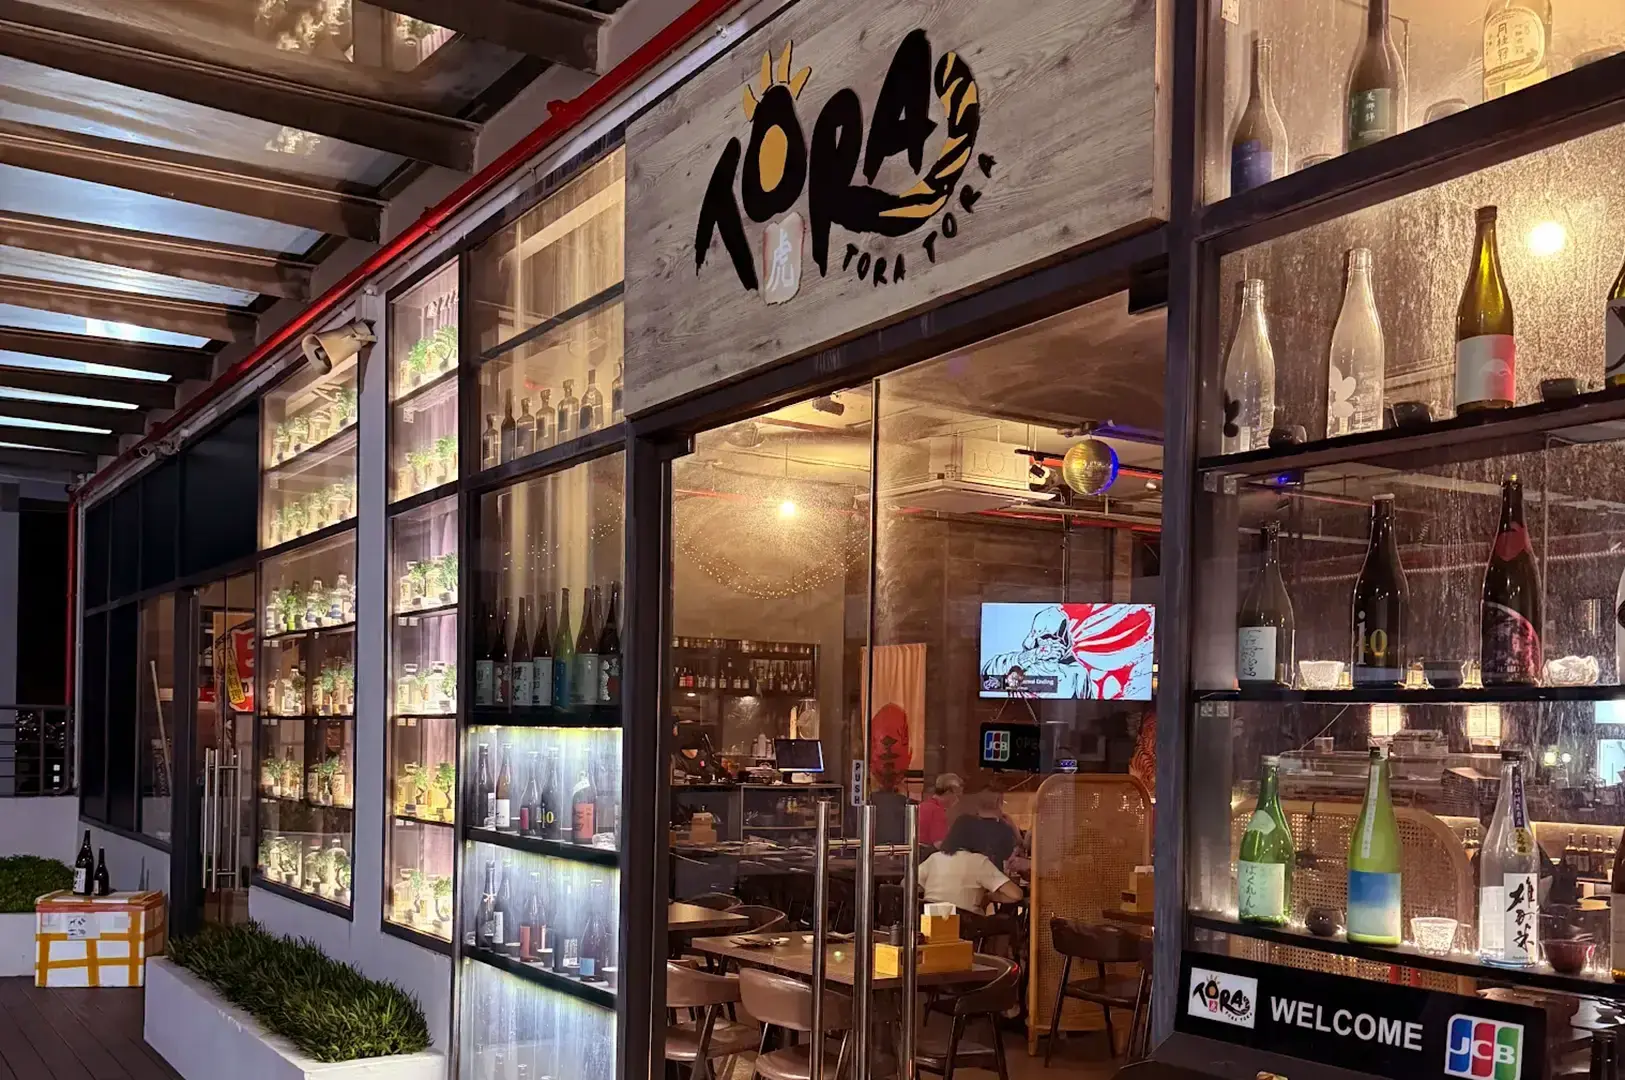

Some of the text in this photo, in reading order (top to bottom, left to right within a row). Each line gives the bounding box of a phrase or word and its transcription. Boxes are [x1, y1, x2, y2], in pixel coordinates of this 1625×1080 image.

[695, 29, 980, 290] TORA
[843, 152, 998, 288] TORA TORA
[766, 228, 795, 288] 虎
[985, 741, 1008, 752] JCB
[1192, 979, 1251, 1017] TORA
[1270, 996, 1424, 1051] WELCOME
[1449, 1036, 1516, 1065] JCB
